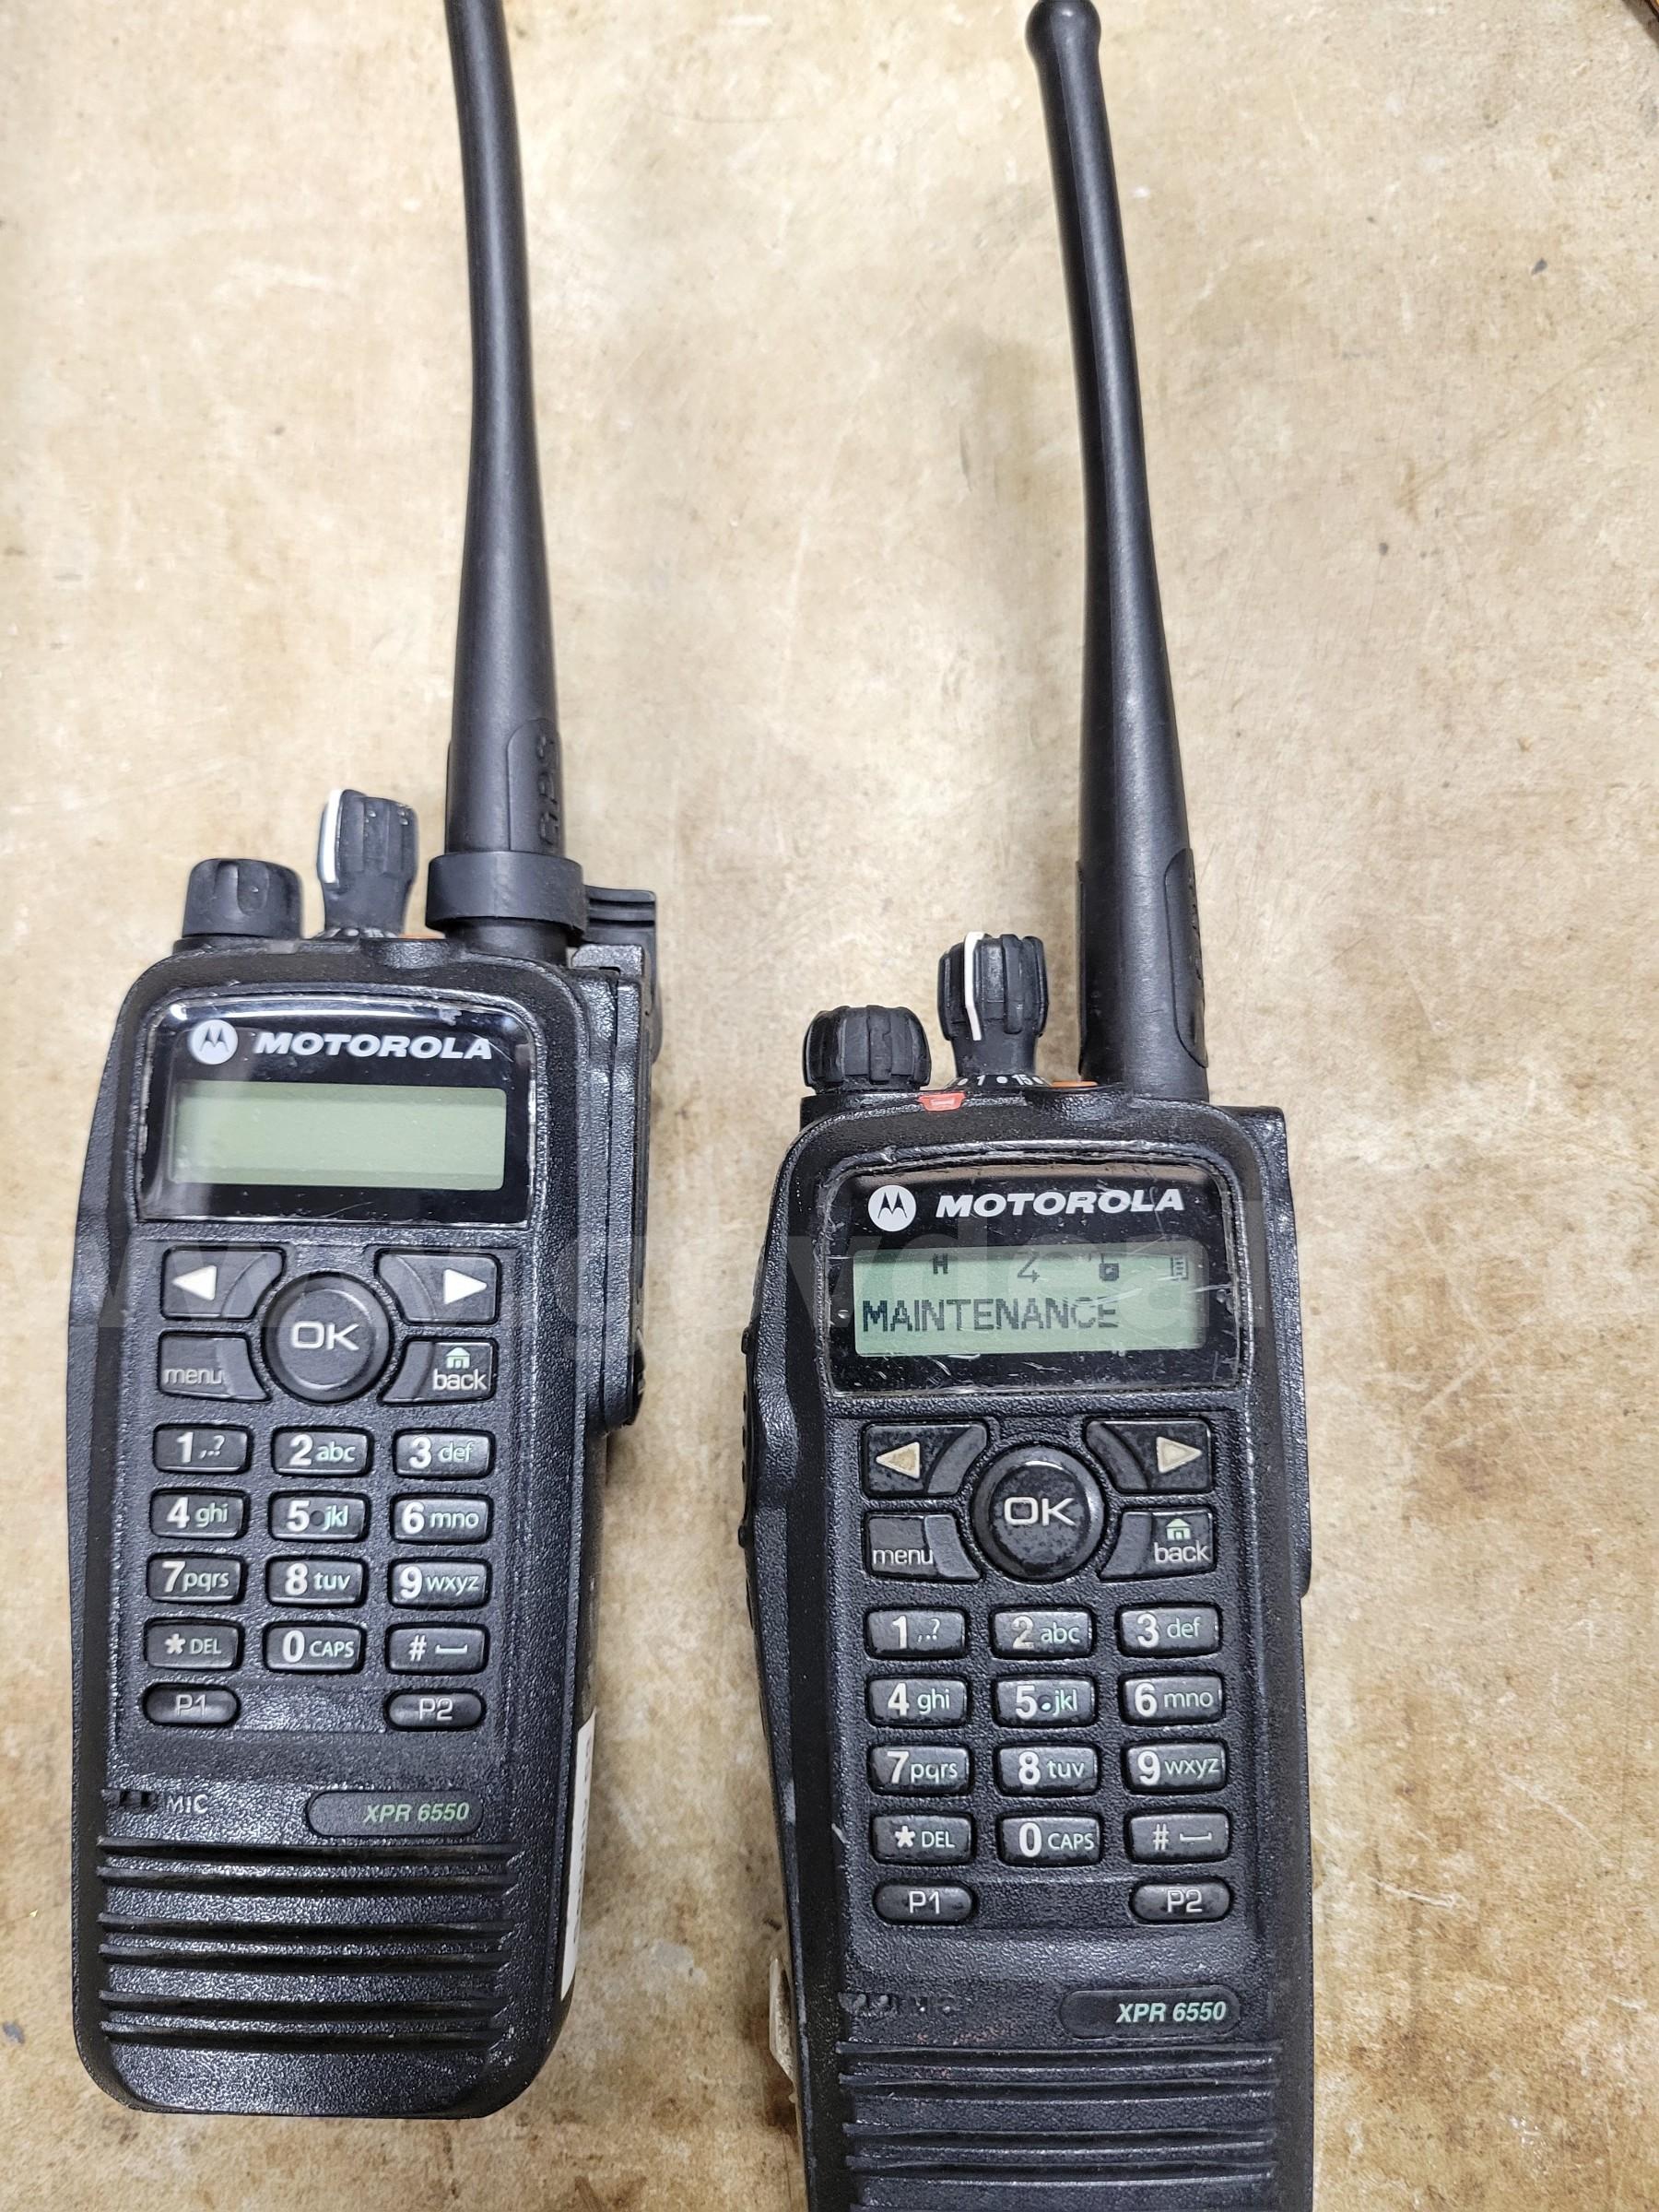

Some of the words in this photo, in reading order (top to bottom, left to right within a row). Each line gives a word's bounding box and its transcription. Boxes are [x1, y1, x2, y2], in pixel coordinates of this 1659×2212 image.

[255, 1032, 492, 1060] MOTOROLA
[935, 1189, 1184, 1218] MOTOROLA
[863, 1296, 1118, 1332] MAINTENANCE
[291, 1322, 359, 1351] OK
[163, 1368, 223, 1385] menu
[434, 1370, 487, 1391] back
[177, 1432, 194, 1462] 1
[289, 1435, 312, 1465] 2
[316, 1441, 355, 1462] abc
[409, 1437, 431, 1466] 3
[437, 1441, 472, 1462] def
[166, 1498, 190, 1528] 4
[194, 1503, 227, 1527] ghi
[286, 1500, 310, 1531] 5
[323, 1505, 347, 1529] jkl
[401, 1503, 425, 1533] 6
[429, 1512, 478, 1529] mno
[1004, 1498, 1075, 1526] OK
[874, 1548, 933, 1565] menu
[1154, 1542, 1208, 1562] back
[162, 1561, 184, 1592] 7
[183, 1569, 229, 1591] pqrs
[286, 1563, 308, 1594] 8
[313, 1571, 350, 1590] tuv
[399, 1567, 421, 1597] 9
[426, 1575, 479, 1594] wxyz
[1013, 1618, 1033, 1649] 2
[1040, 1622, 1079, 1644] abc
[1137, 1614, 1158, 1647] 3
[1167, 1619, 1200, 1640] def
[190, 1639, 221, 1654] DEL
[282, 1630, 305, 1663] 0
[310, 1641, 354, 1658] CAPS
[175, 1696, 206, 1715] P1
[418, 1699, 453, 1720] P2
[887, 1683, 909, 1716] 4
[918, 1688, 950, 1714] ghi
[1016, 1686, 1035, 1718] 5
[1052, 1689, 1077, 1714] jkl
[1135, 1682, 1156, 1715] 6
[1164, 1690, 1213, 1708] mno
[887, 1752, 909, 1783] 7
[911, 1761, 958, 1783] pqrs
[1018, 1751, 1041, 1785] 8
[1047, 1759, 1085, 1778] tuv
[1138, 1751, 1159, 1784] 9
[1164, 1757, 1219, 1778] wxyz
[163, 1794, 209, 1812] MIC
[366, 1804, 409, 1822] XPR
[417, 1803, 469, 1821] 6550
[922, 1830, 954, 1848] DEL
[1019, 1823, 1041, 1857] 0
[1048, 1833, 1094, 1851] CAPS
[909, 1892, 940, 1914] P1
[1167, 1890, 1203, 1912] P2
[1116, 2004, 1166, 2023] XPR
[1172, 2002, 1226, 2022] 6550
